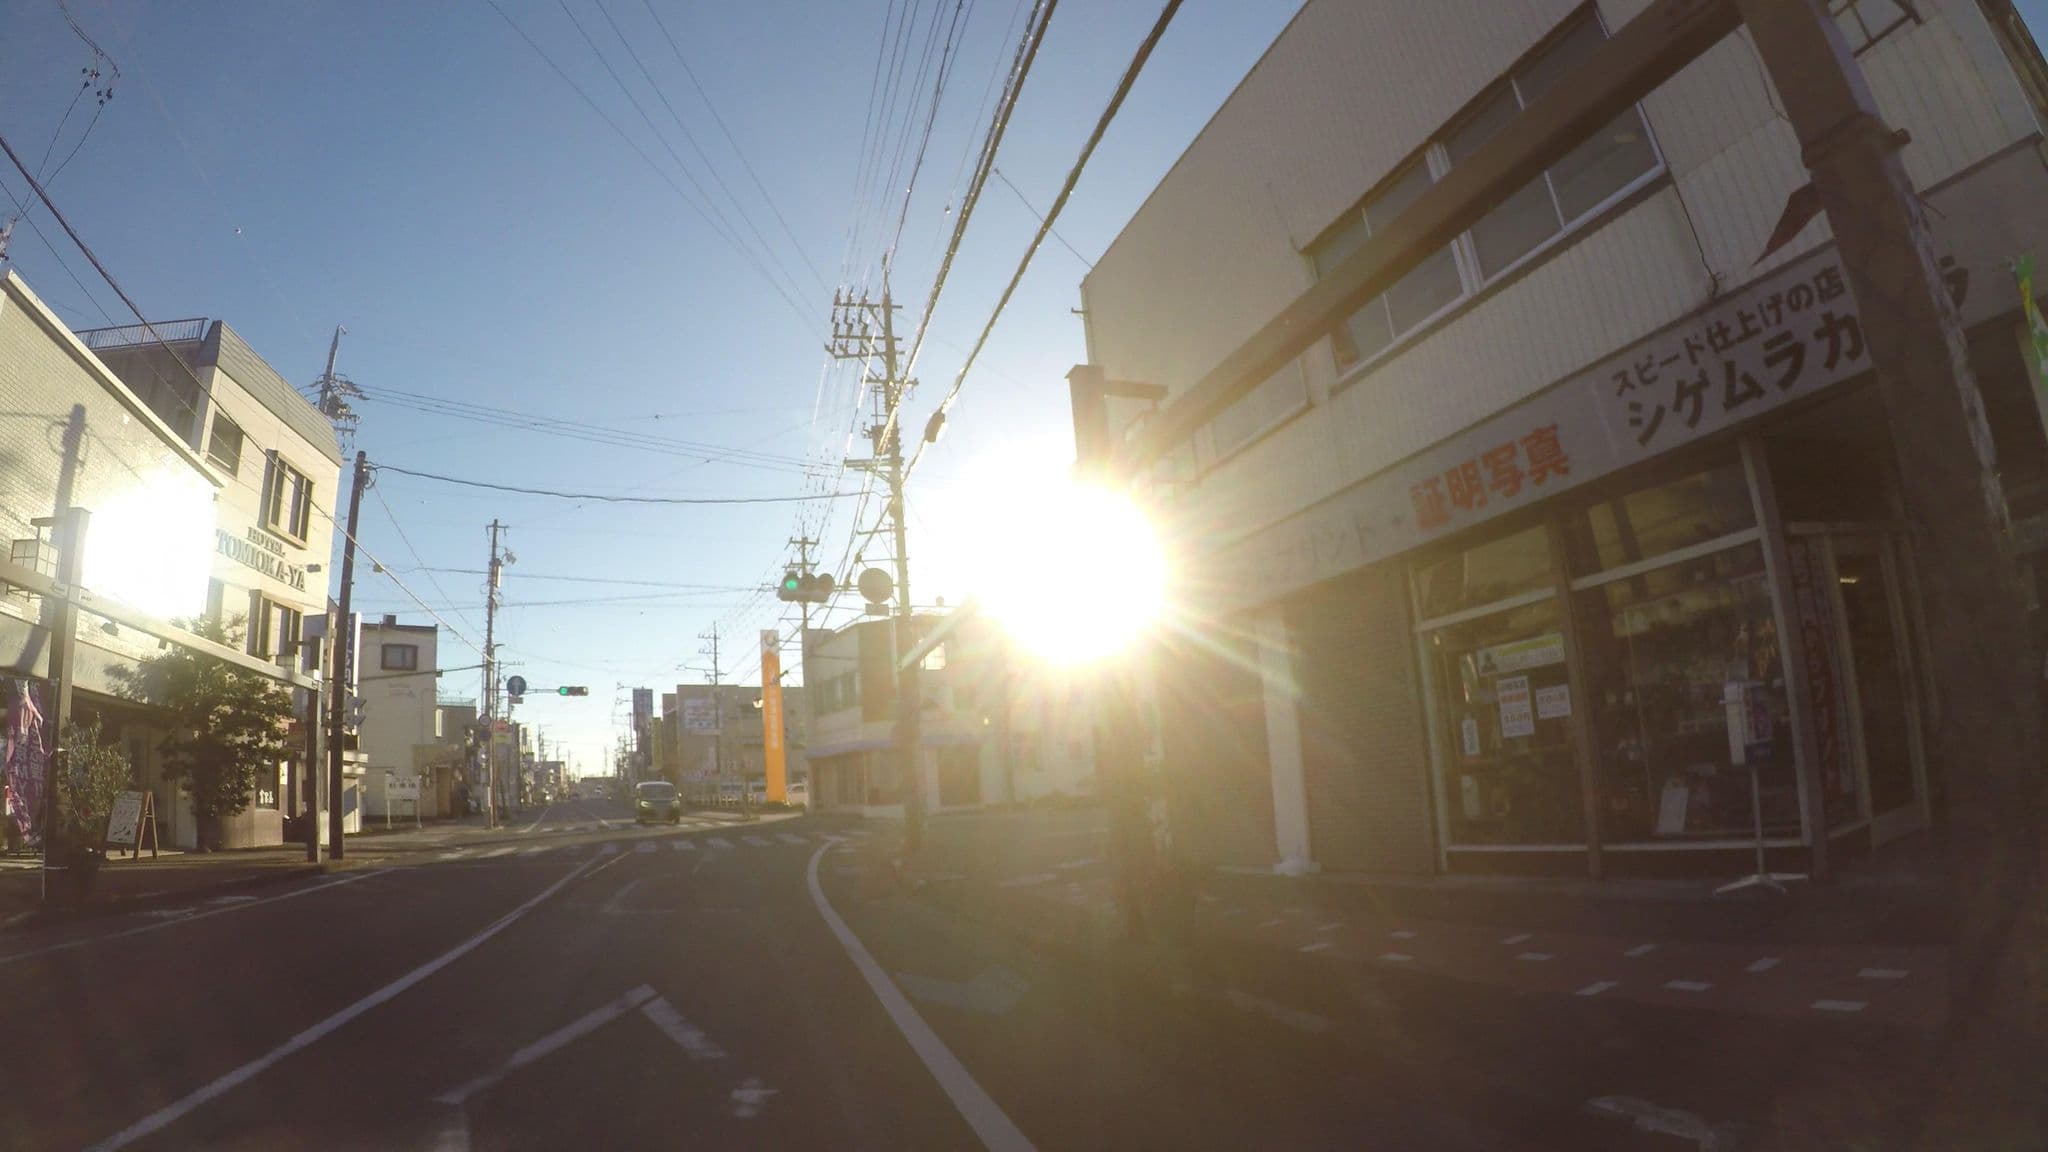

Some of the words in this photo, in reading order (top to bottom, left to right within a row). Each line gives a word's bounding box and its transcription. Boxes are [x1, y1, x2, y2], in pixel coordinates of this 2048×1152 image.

[1612, 265, 1846, 397] スピード仕上げの店
[215, 528, 306, 592] TOMOKA-YA
[247, 526, 286, 558] HOTEL
